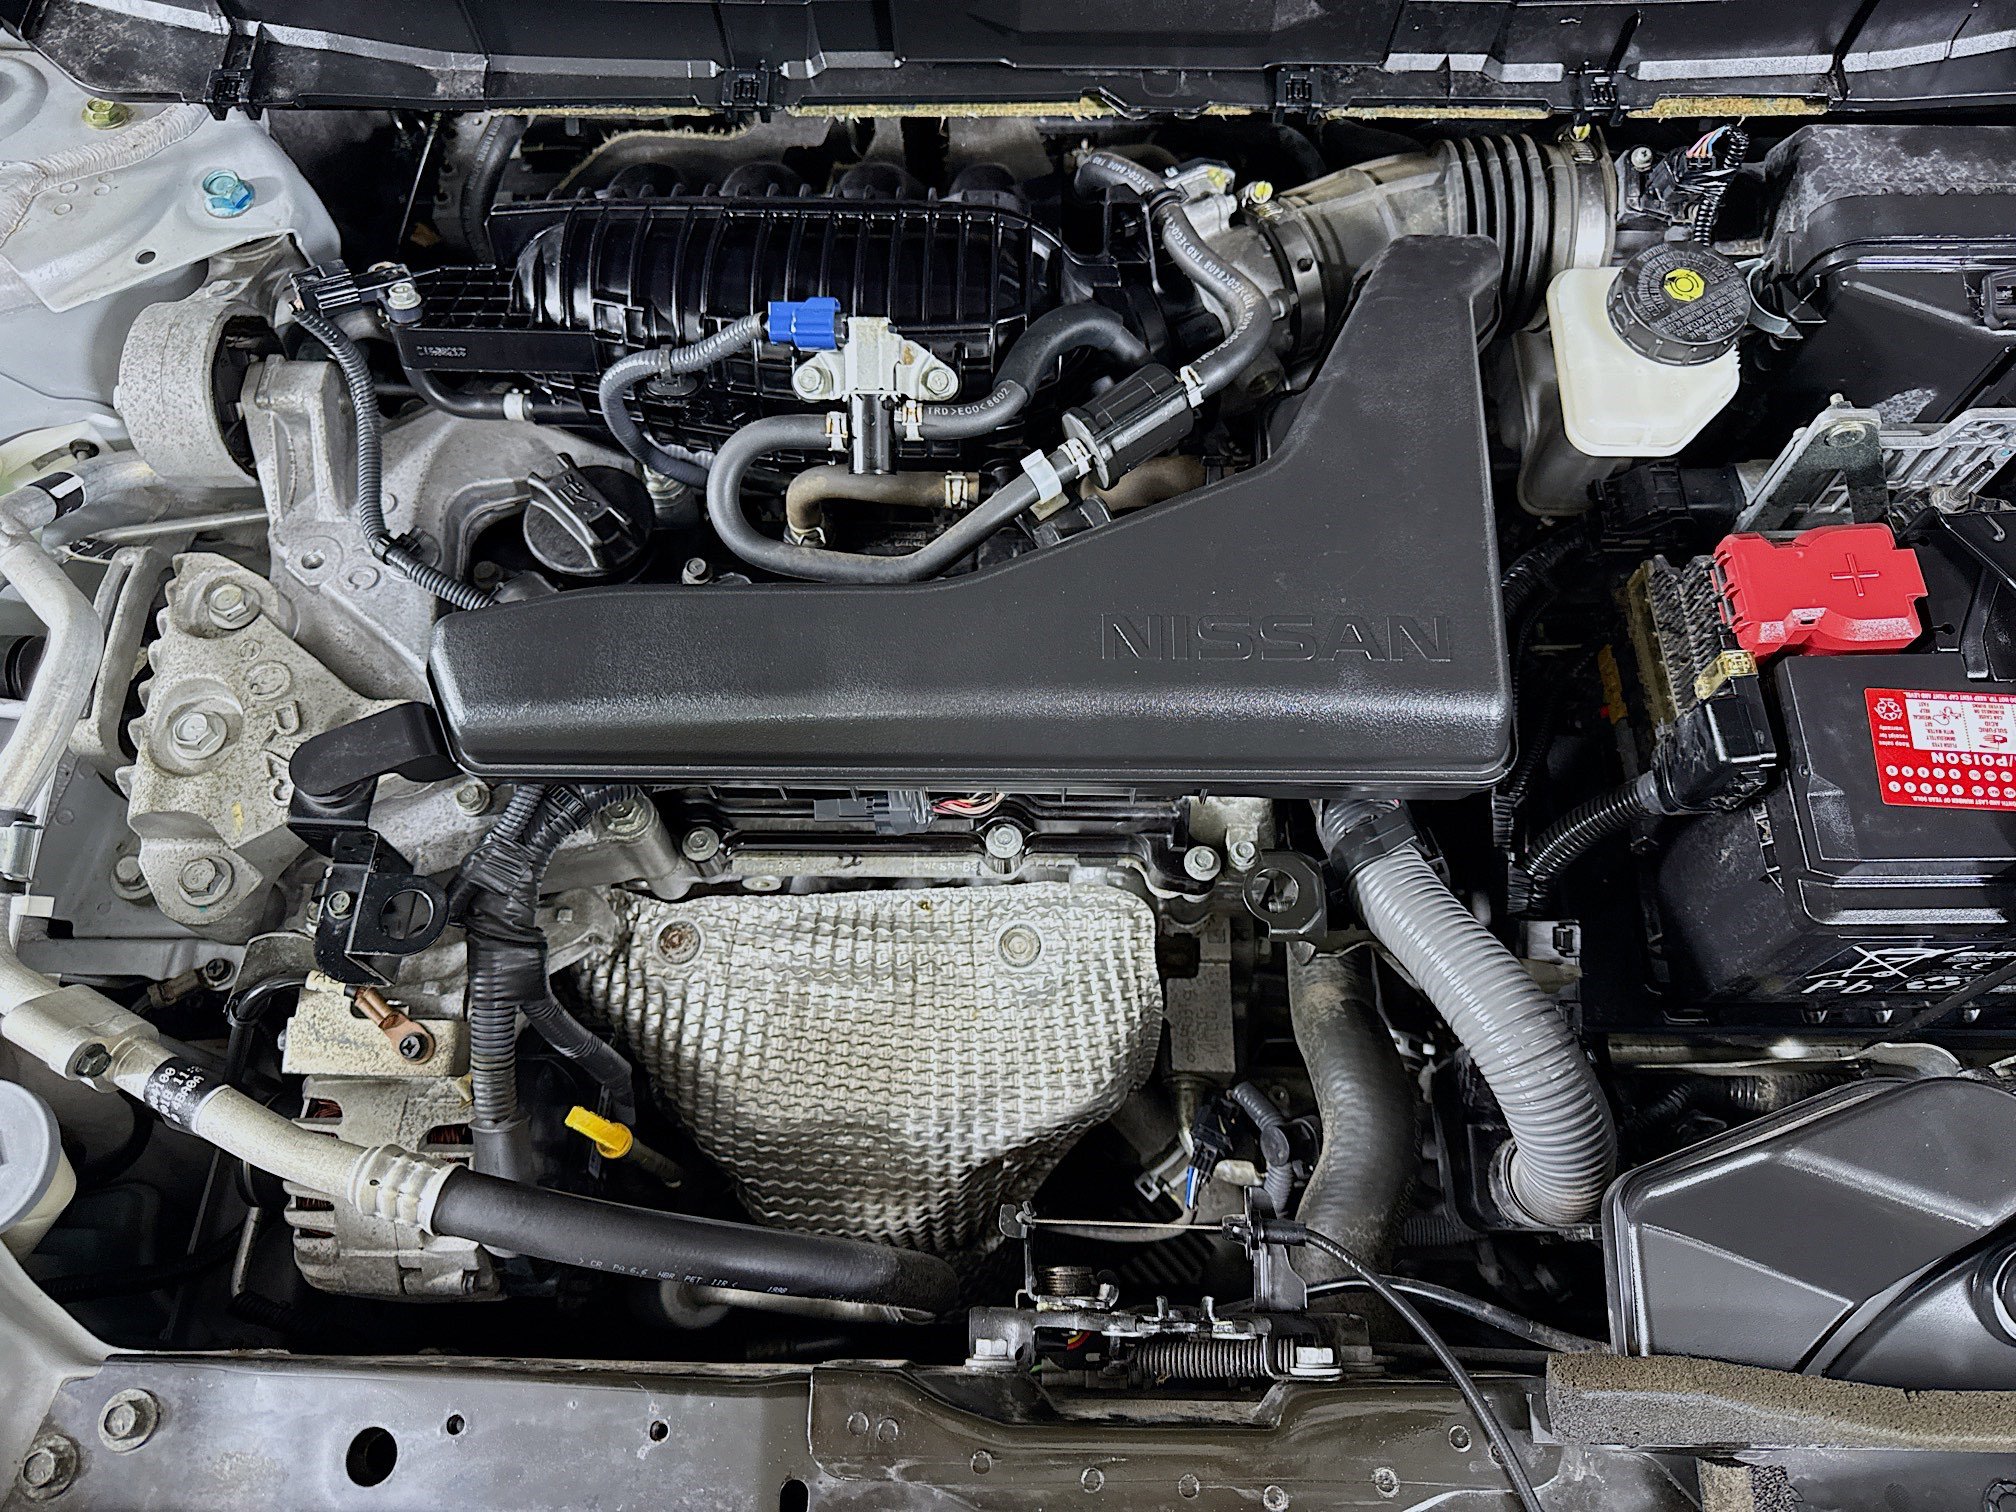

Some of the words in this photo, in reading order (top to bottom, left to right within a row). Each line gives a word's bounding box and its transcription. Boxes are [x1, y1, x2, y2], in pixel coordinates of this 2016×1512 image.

[1101, 614, 1452, 661] NISSAN
[1931, 752, 2016, 767] /POISON
[1801, 979, 1873, 994] Pb
[684, 1274, 702, 1284] PET
